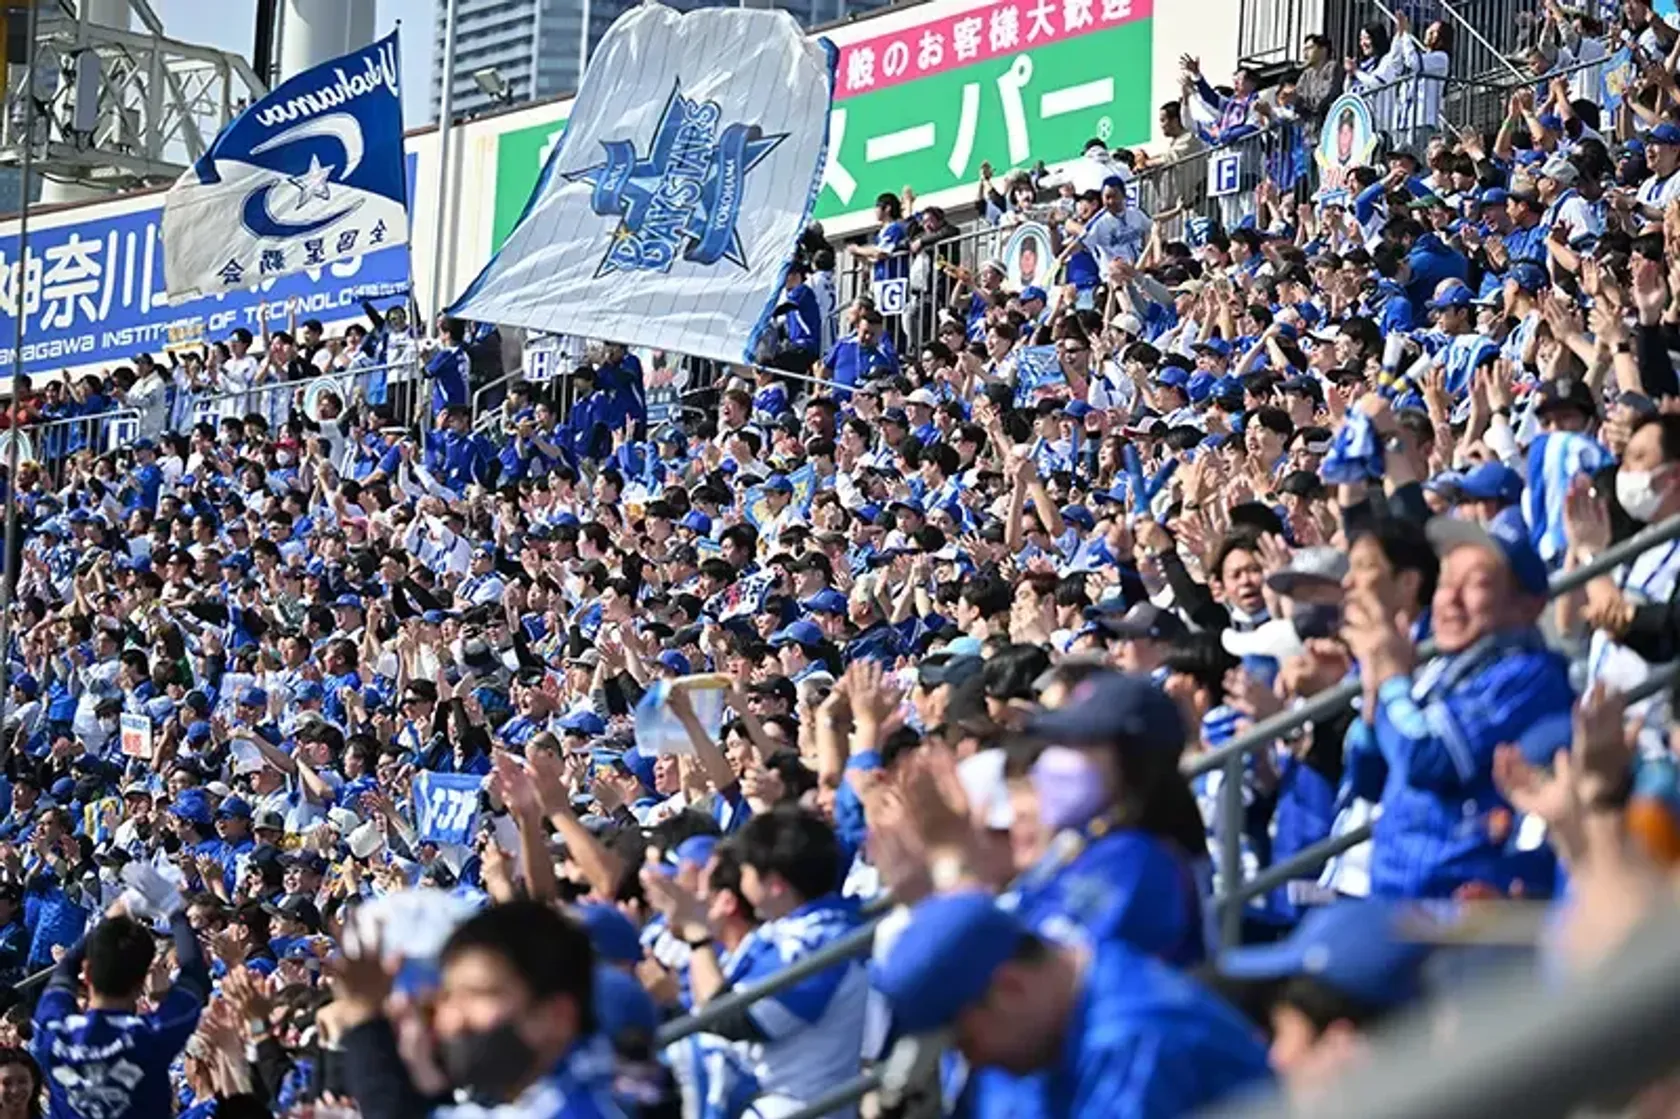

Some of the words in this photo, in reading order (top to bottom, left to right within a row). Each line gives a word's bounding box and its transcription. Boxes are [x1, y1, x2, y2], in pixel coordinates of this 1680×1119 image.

[835, 0, 1132, 90] 般のお客様大歓迎
[608, 98, 722, 274] BAYSTARS
[714, 158, 736, 231] YOKOHAMA
[1220, 160, 1234, 190] F
[0, 222, 168, 336] 神奈川
[883, 282, 902, 311] G
[209, 310, 238, 332] OF
[244, 287, 355, 327] TECHNOLO
[533, 351, 550, 378] H
